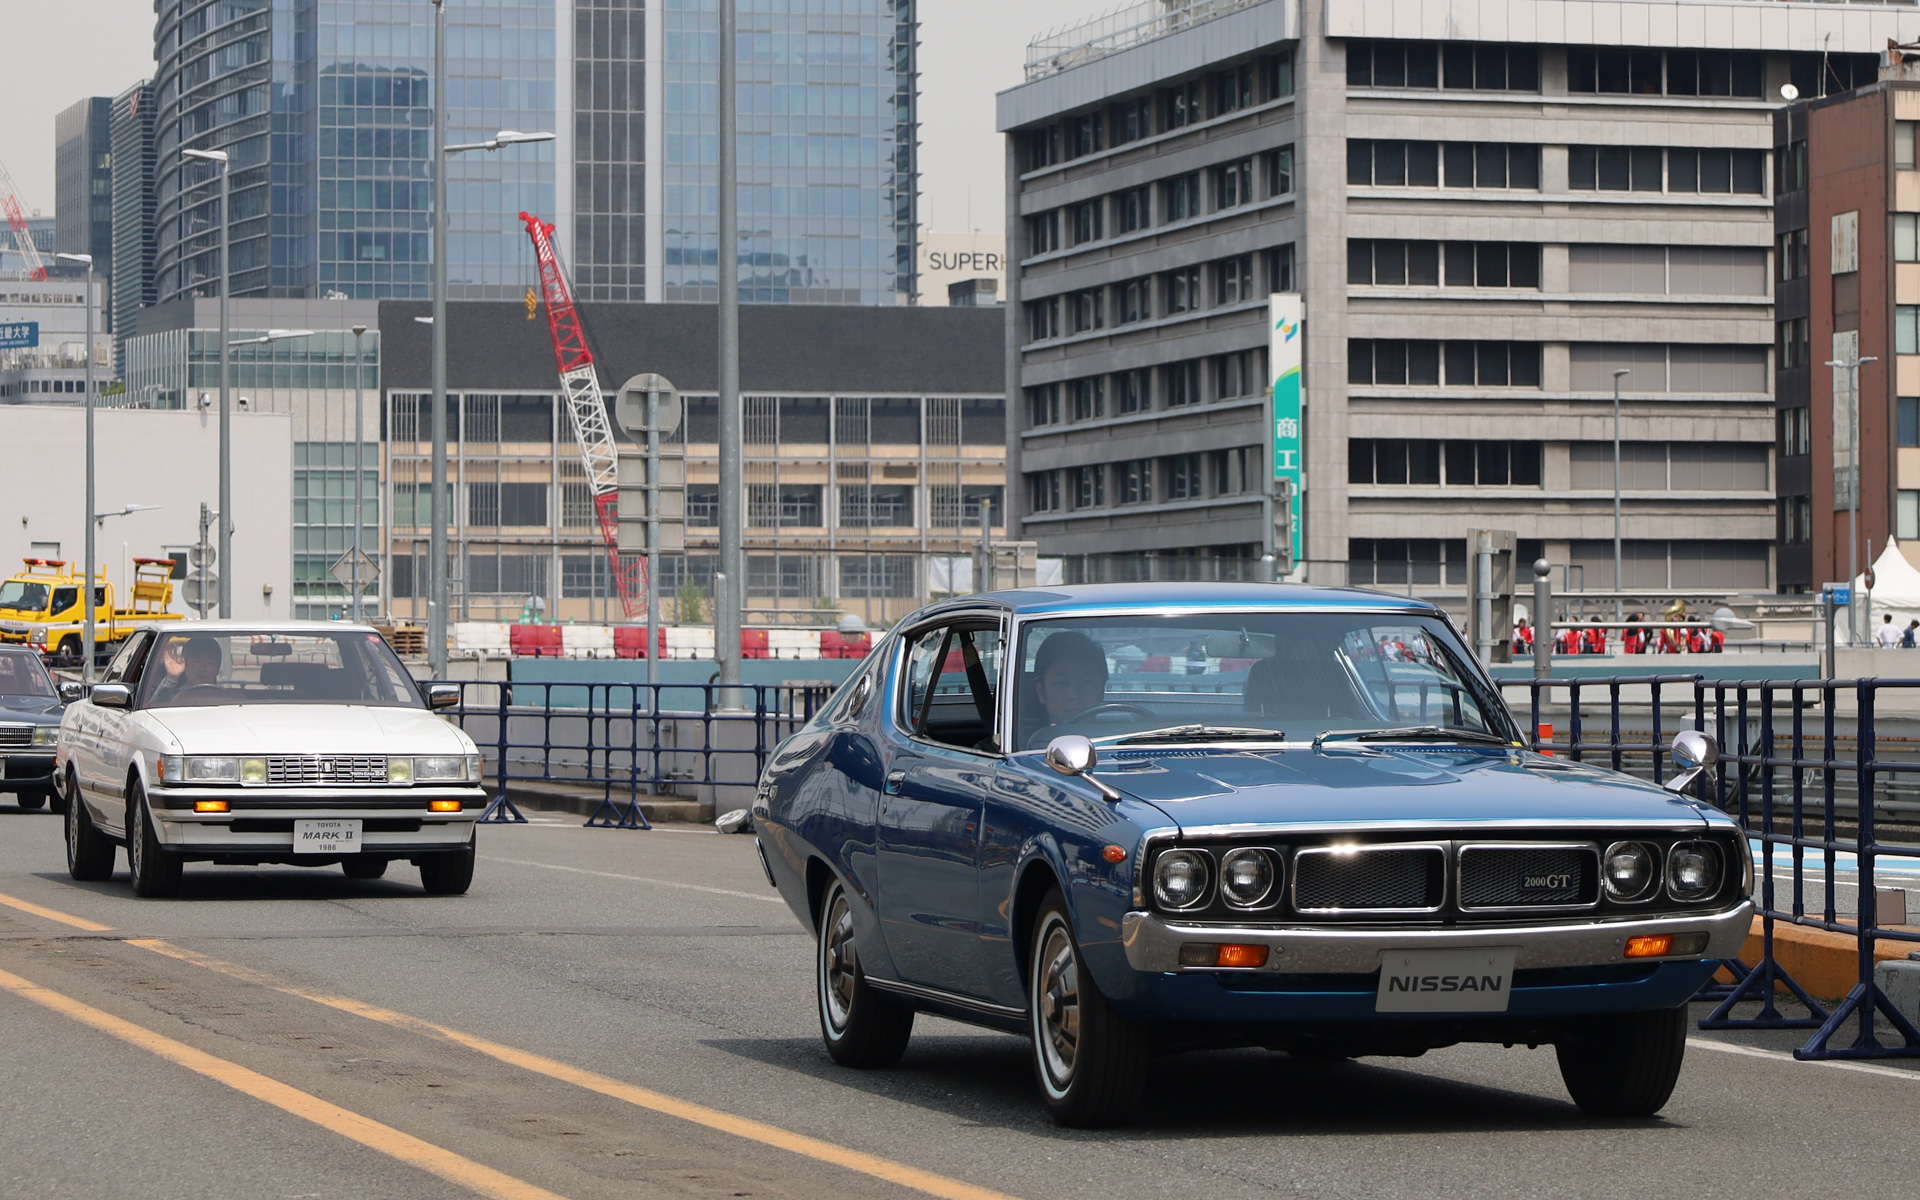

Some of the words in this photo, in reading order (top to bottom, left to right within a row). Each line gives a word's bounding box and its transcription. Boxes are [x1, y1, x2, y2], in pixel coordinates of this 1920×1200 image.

[302, 831, 340, 839] MARK
[1524, 874, 1571, 889] 2000GT
[1388, 975, 1502, 992] NISSAN
